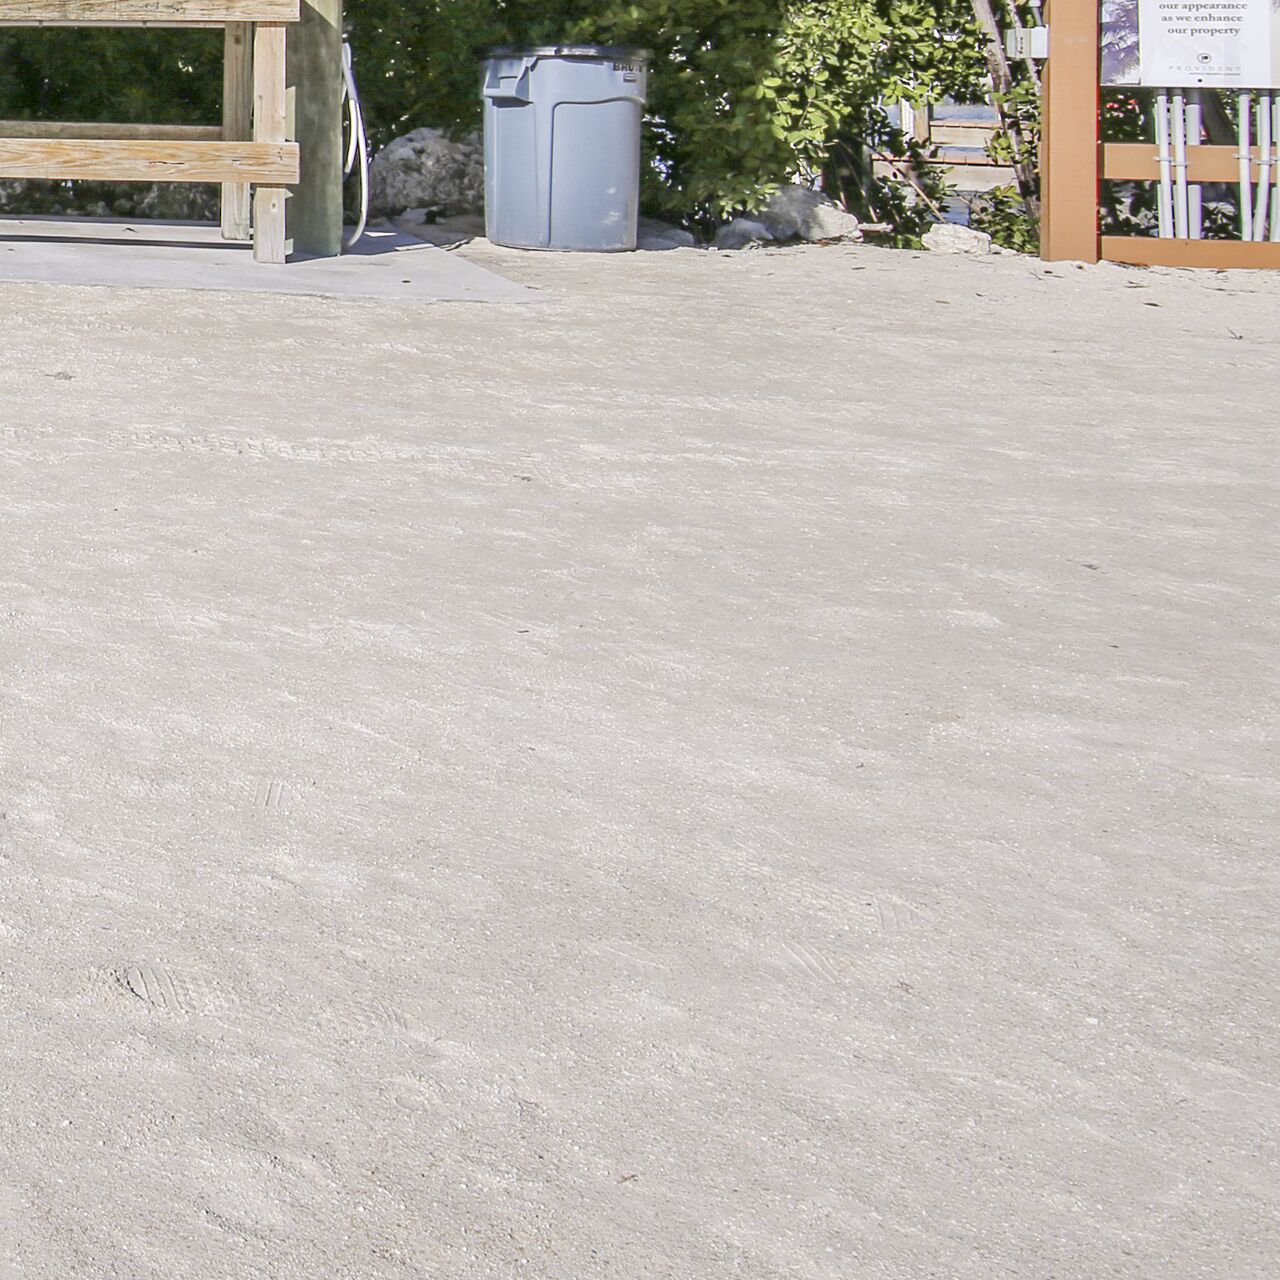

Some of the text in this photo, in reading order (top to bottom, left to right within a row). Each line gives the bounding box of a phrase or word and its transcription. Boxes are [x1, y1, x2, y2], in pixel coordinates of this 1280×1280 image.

[1181, 3, 1248, 11] appearance
[1161, 14, 1173, 22] as
[1194, 12, 1244, 22] enhance
[1190, 27, 1240, 36] property
